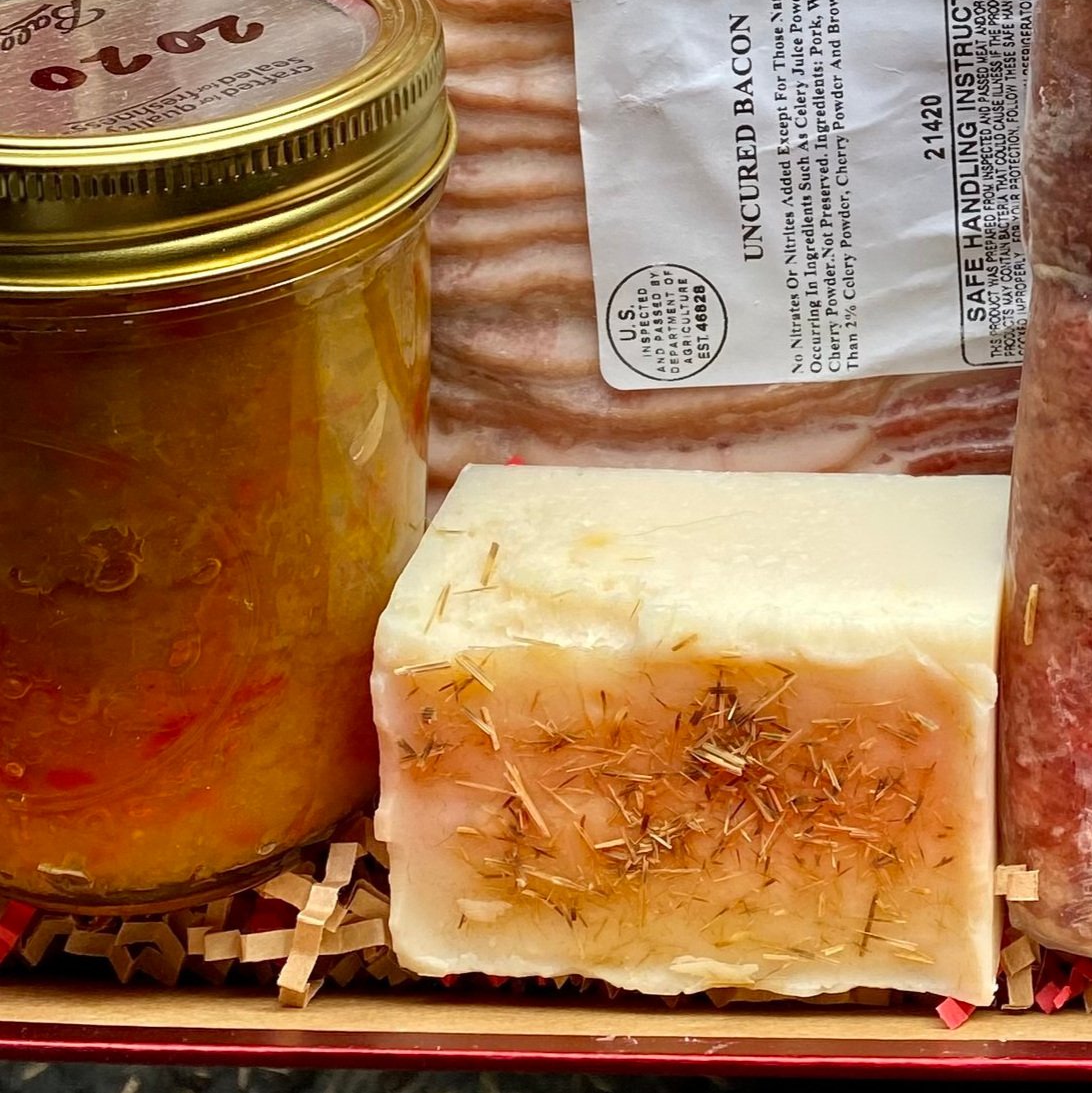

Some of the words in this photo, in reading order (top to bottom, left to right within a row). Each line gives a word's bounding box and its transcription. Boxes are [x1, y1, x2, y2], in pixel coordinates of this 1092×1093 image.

[773, 27, 785, 71] Those
[791, 38, 805, 76] Juice
[808, 15, 824, 56] Pork,
[828, 40, 842, 70] And
[217, 56, 304, 84] sealed
[221, 65, 314, 98] crafted
[729, 14, 755, 116] BACON
[775, 76, 787, 101] For
[794, 81, 808, 128] Celery
[812, 61, 830, 150] Ingredients:
[831, 75, 845, 130] Powder
[777, 106, 792, 155] Except
[798, 133, 808, 152] As
[921, 95, 945, 160] 21420
[778, 160, 794, 207] Added
[797, 156, 811, 190] Such
[835, 135, 849, 186] Cherry
[736, 125, 764, 262] UNCURED
[816, 154, 833, 228] Preserved.
[957, 122, 983, 248] HANDLING
[783, 211, 797, 265] Nitrites
[801, 195, 819, 276] Ingredients
[838, 190, 852, 248] Powder,
[650, 272, 660, 286] BY
[664, 271, 673, 285] OF
[786, 270, 799, 289] Or
[805, 281, 818, 297] In
[842, 253, 857, 300] Celery
[964, 258, 986, 321] SAFE
[638, 288, 652, 357] INSPECTED
[652, 293, 663, 341] PASSED
[678, 279, 693, 364] AGRICULTURE
[693, 285, 708, 331] 46828
[789, 294, 803, 349] Nitrates
[845, 305, 857, 328] 2%
[666, 292, 679, 373] DEPARTMENT
[807, 300, 822, 374] Occurring
[828, 321, 842, 372] Cherry
[847, 333, 859, 371] Than
[656, 348, 666, 372] AND
[792, 354, 804, 374] No
